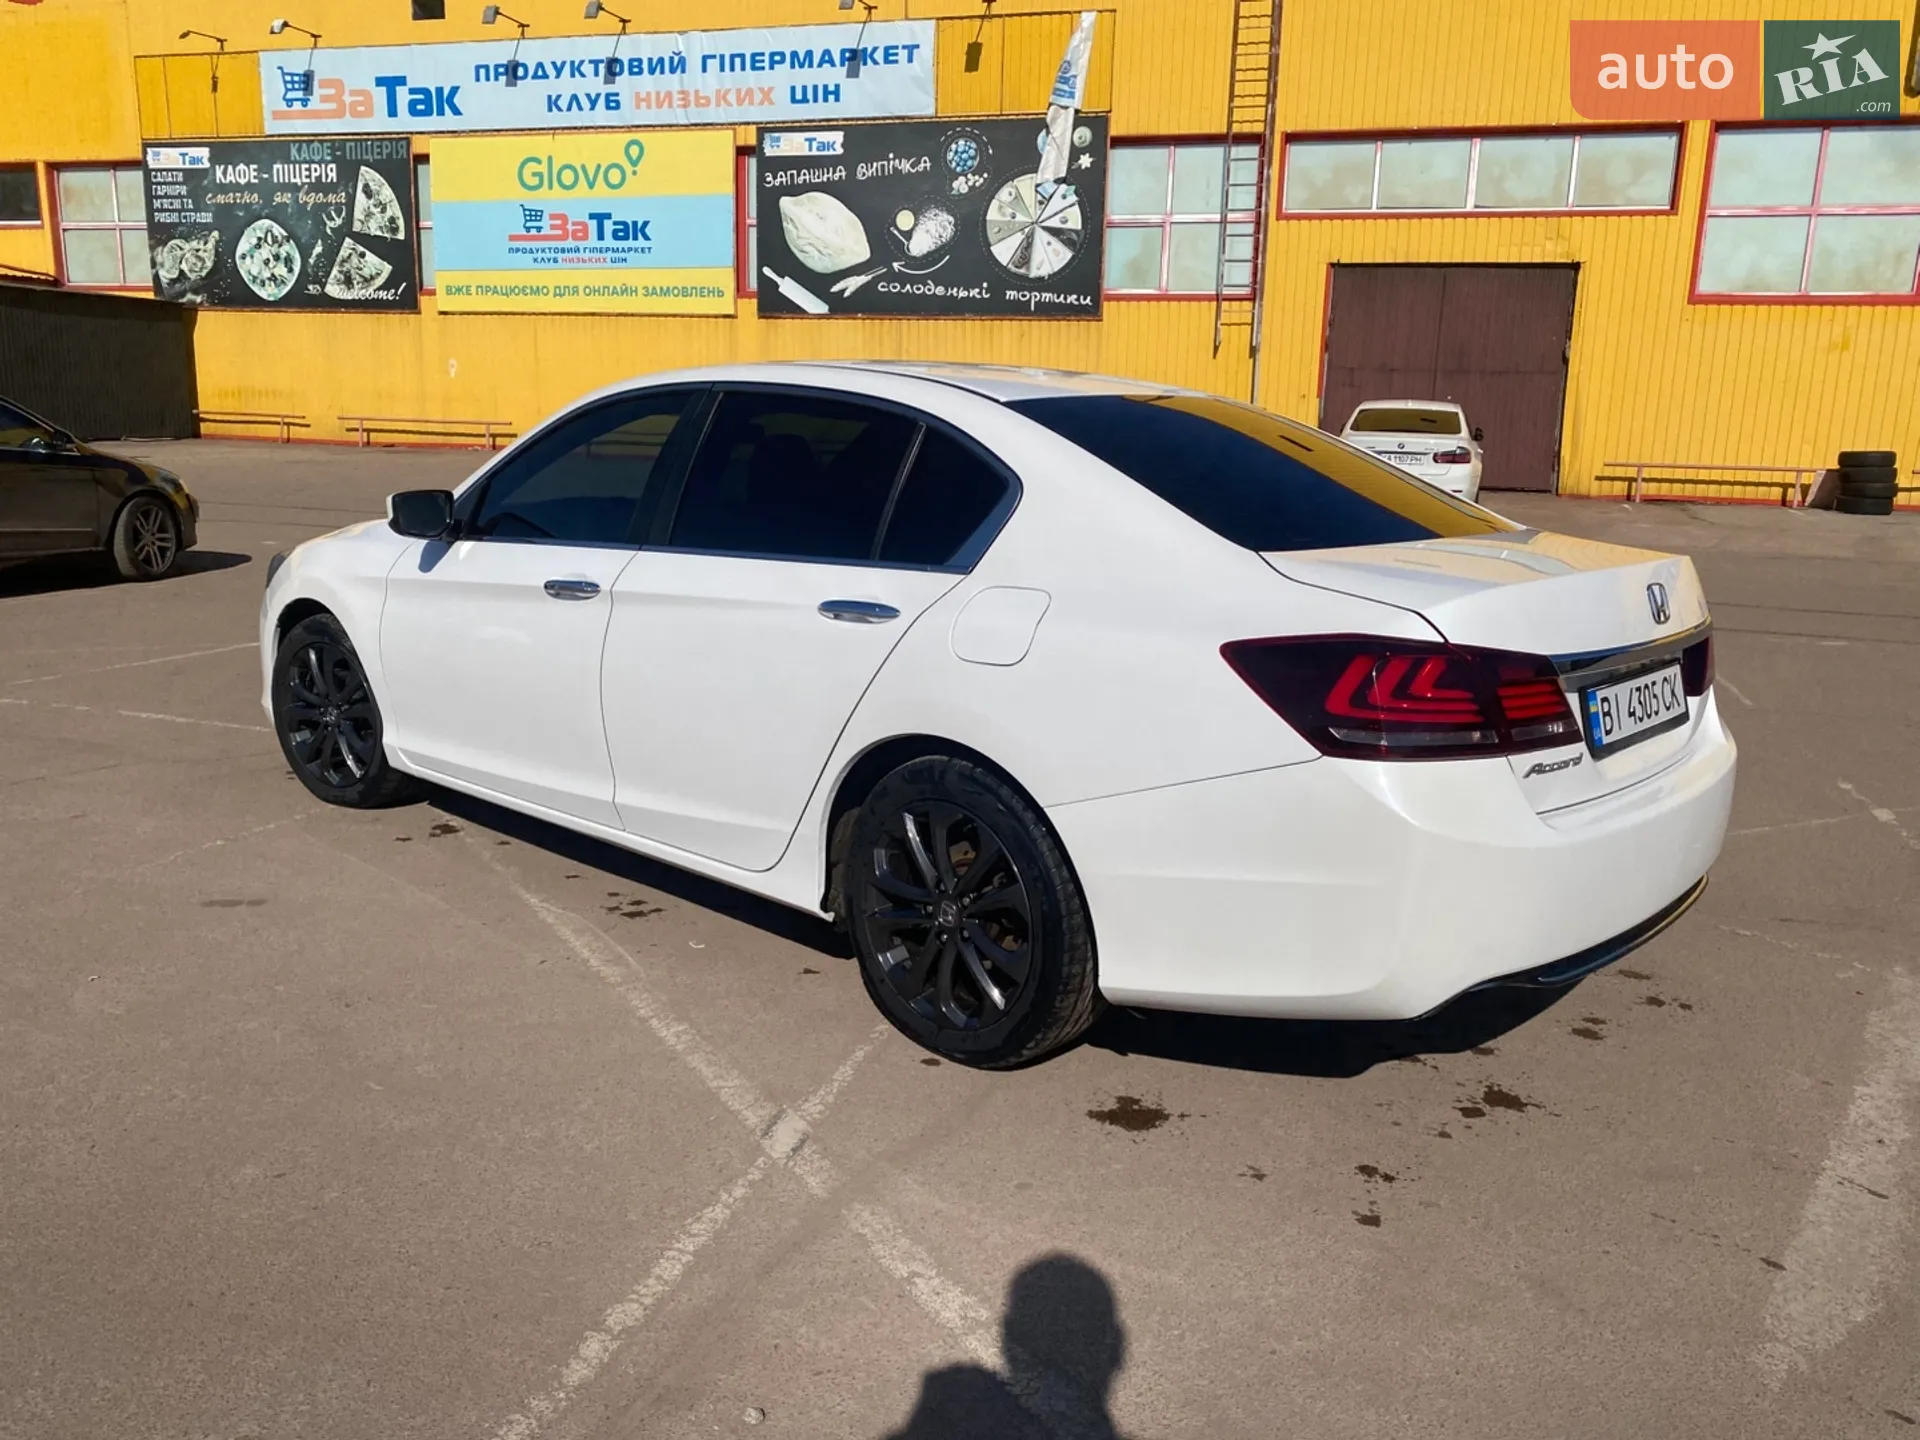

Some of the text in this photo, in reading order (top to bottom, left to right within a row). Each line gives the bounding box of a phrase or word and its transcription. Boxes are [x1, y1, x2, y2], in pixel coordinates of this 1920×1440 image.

[474, 44, 920, 82] ПРОДУКТОВИЙ ГІПЕРМАРКЕТ
[318, 75, 463, 120] ЗаТак
[546, 84, 841, 112] КЛУБ НИЗЬКИХ ЦІН
[290, 143, 332, 161] КАФЕ
[345, 140, 407, 162] ПІЦЕРІЯ
[151, 171, 183, 182] САЛАТИ
[215, 163, 259, 185] КАФЕ
[273, 163, 337, 185] ПІЦЕРІЯ
[517, 154, 627, 192] Glovo
[763, 153, 931, 187] ЗАПАШНА ВИПІЧКА
[183, 198, 194, 209] ТА
[272, 192, 292, 206] як
[181, 211, 213, 222] СТРАВИ
[548, 212, 652, 242] ЗаТак
[508, 246, 653, 254] ПРОДУКТОВИЙ ГІПЕРМАРКЕТ
[533, 256, 628, 264] КЛУБ НИЗЬКИХ ЦІН
[445, 284, 725, 298] ВЖЕ ПРАЦЮЄМО ДЛЯ ОНЛАЙН ЗАМОВЛЕНЬ
[877, 280, 1093, 311] солоденькі тортики
[1601, 673, 1681, 736] BI 4305 CK
[1523, 752, 1583, 779] Accord
